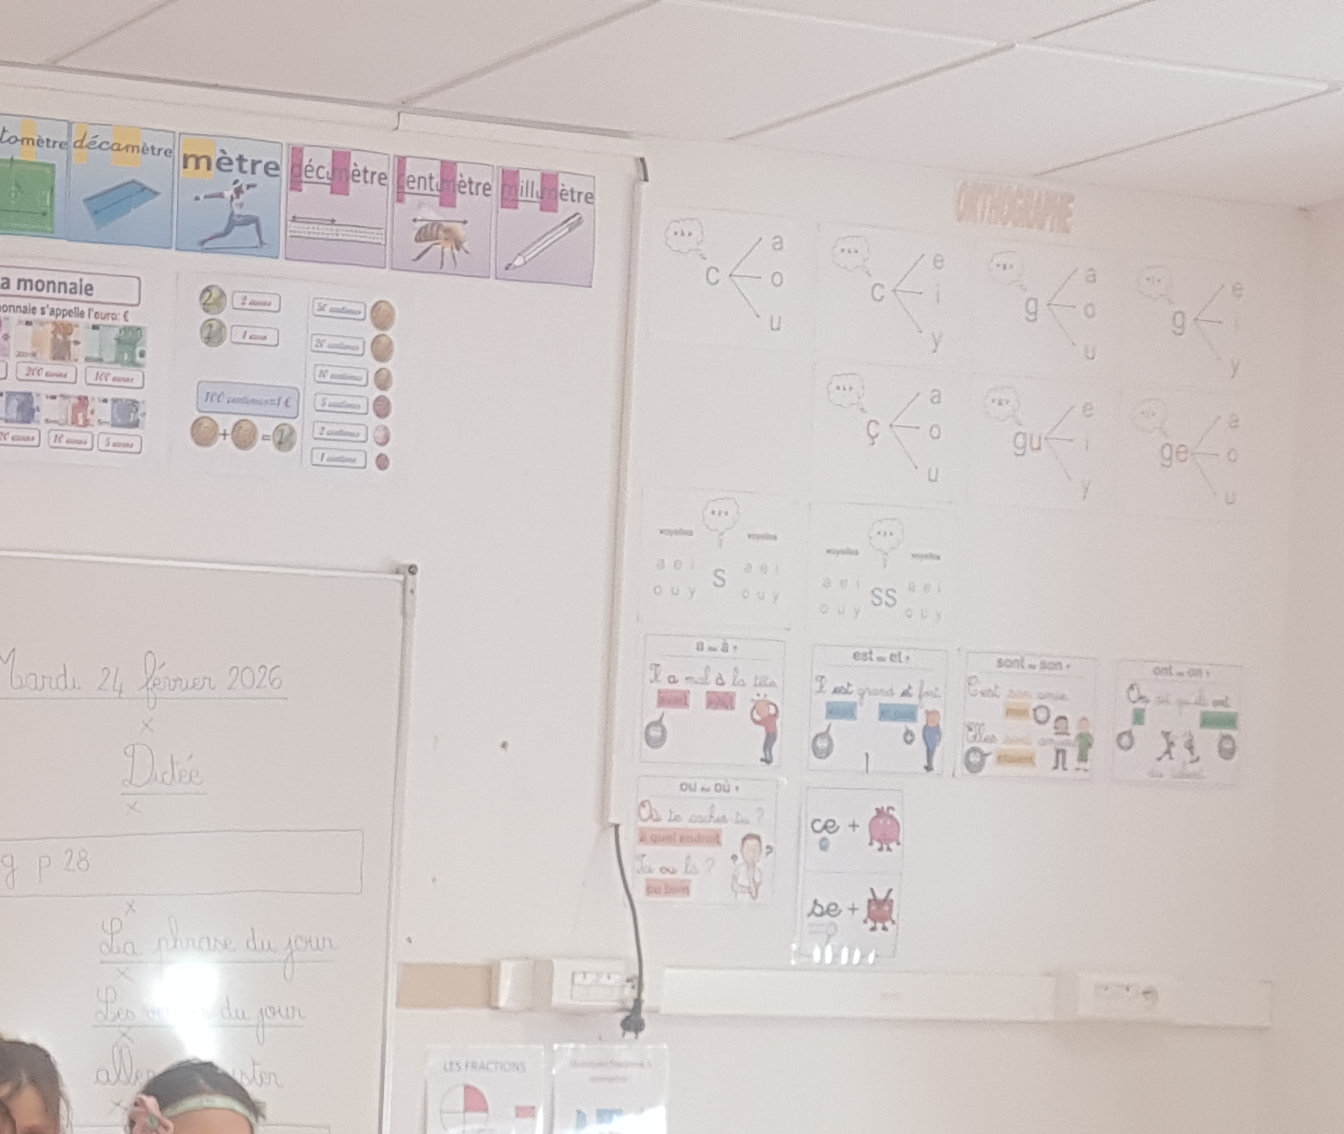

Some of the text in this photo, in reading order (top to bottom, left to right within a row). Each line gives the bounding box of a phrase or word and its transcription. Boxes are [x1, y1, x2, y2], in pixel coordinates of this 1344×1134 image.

[72, 130, 174, 159] décamètre
[181, 146, 281, 178] mètre
[16, 277, 94, 297] monnaie
[40, 304, 86, 321] s'appelle
[97, 667, 125, 698] 24
[141, 651, 217, 711] février
[227, 664, 284, 690] 2026
[122, 743, 204, 788] Dictée
[811, 818, 840, 834] ce
[64, 848, 91, 872] 28
[99, 917, 141, 956] La
[245, 927, 274, 953] du
[284, 935, 338, 983] jour
[220, 996, 248, 1021] du
[443, 1061, 528, 1074] LES FRACTIONS
